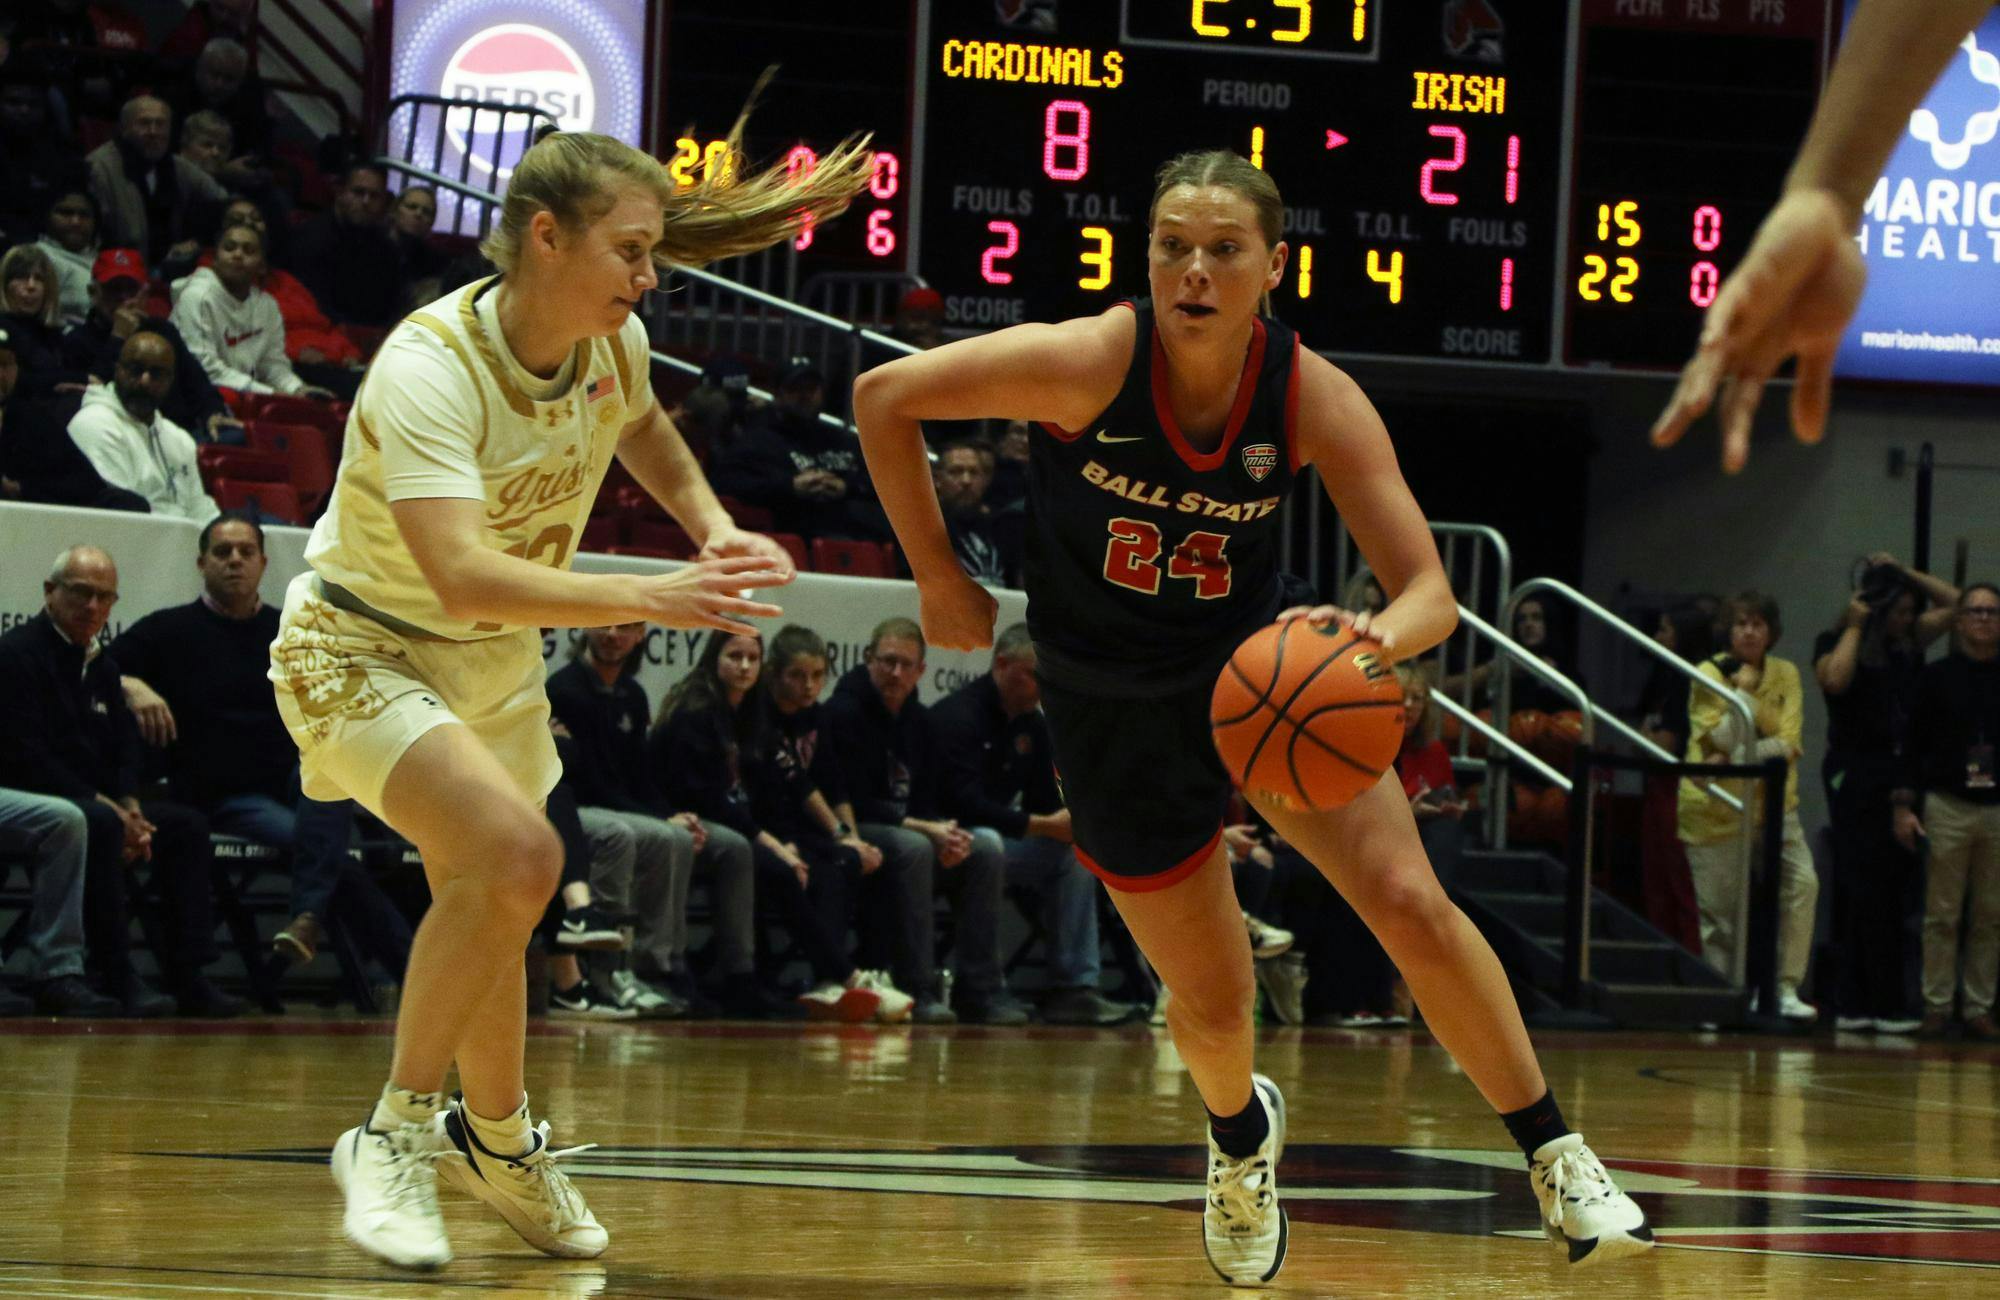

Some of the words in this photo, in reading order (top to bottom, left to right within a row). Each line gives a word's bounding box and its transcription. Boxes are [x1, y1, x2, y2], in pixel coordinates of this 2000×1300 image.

[1749, 0, 1785, 24] PTS
[943, 39, 1124, 88] CARDINALS
[453, 84, 582, 120] PEPSI
[1203, 79, 1292, 110] PERIOD
[1412, 72, 1506, 114] IRISH
[1044, 100, 1090, 180] 8
[869, 152, 898, 199] 0
[1420, 125, 1520, 204] 21
[953, 185, 1033, 215] FOULS
[1064, 193, 1131, 221] T.O.L.
[1283, 207, 1327, 236] OUL
[867, 209, 895, 256] 6
[1356, 212, 1421, 240] T.O.L.
[1449, 217, 1526, 246] FOULS
[1598, 201, 1640, 246] 15
[1693, 205, 1721, 251] 0
[981, 221, 1019, 284] 2
[1079, 227, 1112, 290] 3
[1299, 245, 1312, 299] 1
[1367, 250, 1403, 304] 4
[1500, 257, 1514, 311] 1
[1578, 255, 1639, 302] 22
[1690, 261, 1718, 307] 0
[945, 296, 1024, 325] SCORE
[1442, 326, 1521, 356] SCORE
[1246, 456, 1277, 466] MAC
[1080, 459, 1170, 508] BALL
[1176, 492, 1281, 522] STATE
[1103, 517, 1231, 600] 24
[215, 844, 242, 858] BALL
